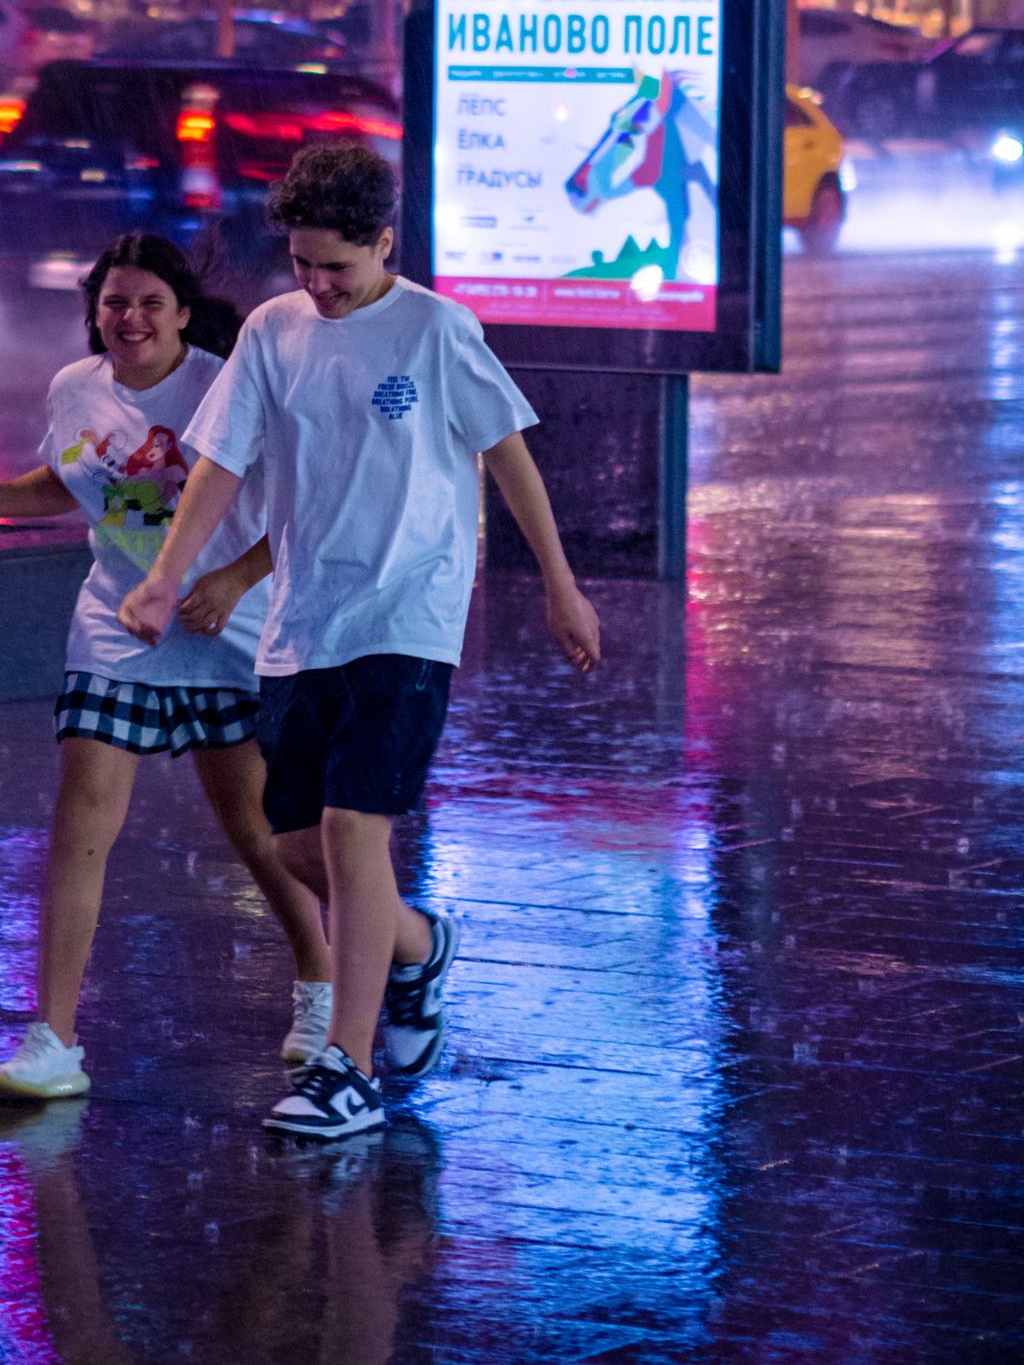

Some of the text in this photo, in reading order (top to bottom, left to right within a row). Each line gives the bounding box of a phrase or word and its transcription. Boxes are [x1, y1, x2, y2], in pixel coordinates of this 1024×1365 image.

[448, 13, 714, 56] ИВАНОВО ПОЛЕ
[457, 98, 506, 116] ЛЕПС
[457, 128, 506, 150] ЁЛКА
[457, 169, 542, 189] ГРАДУСЫ
